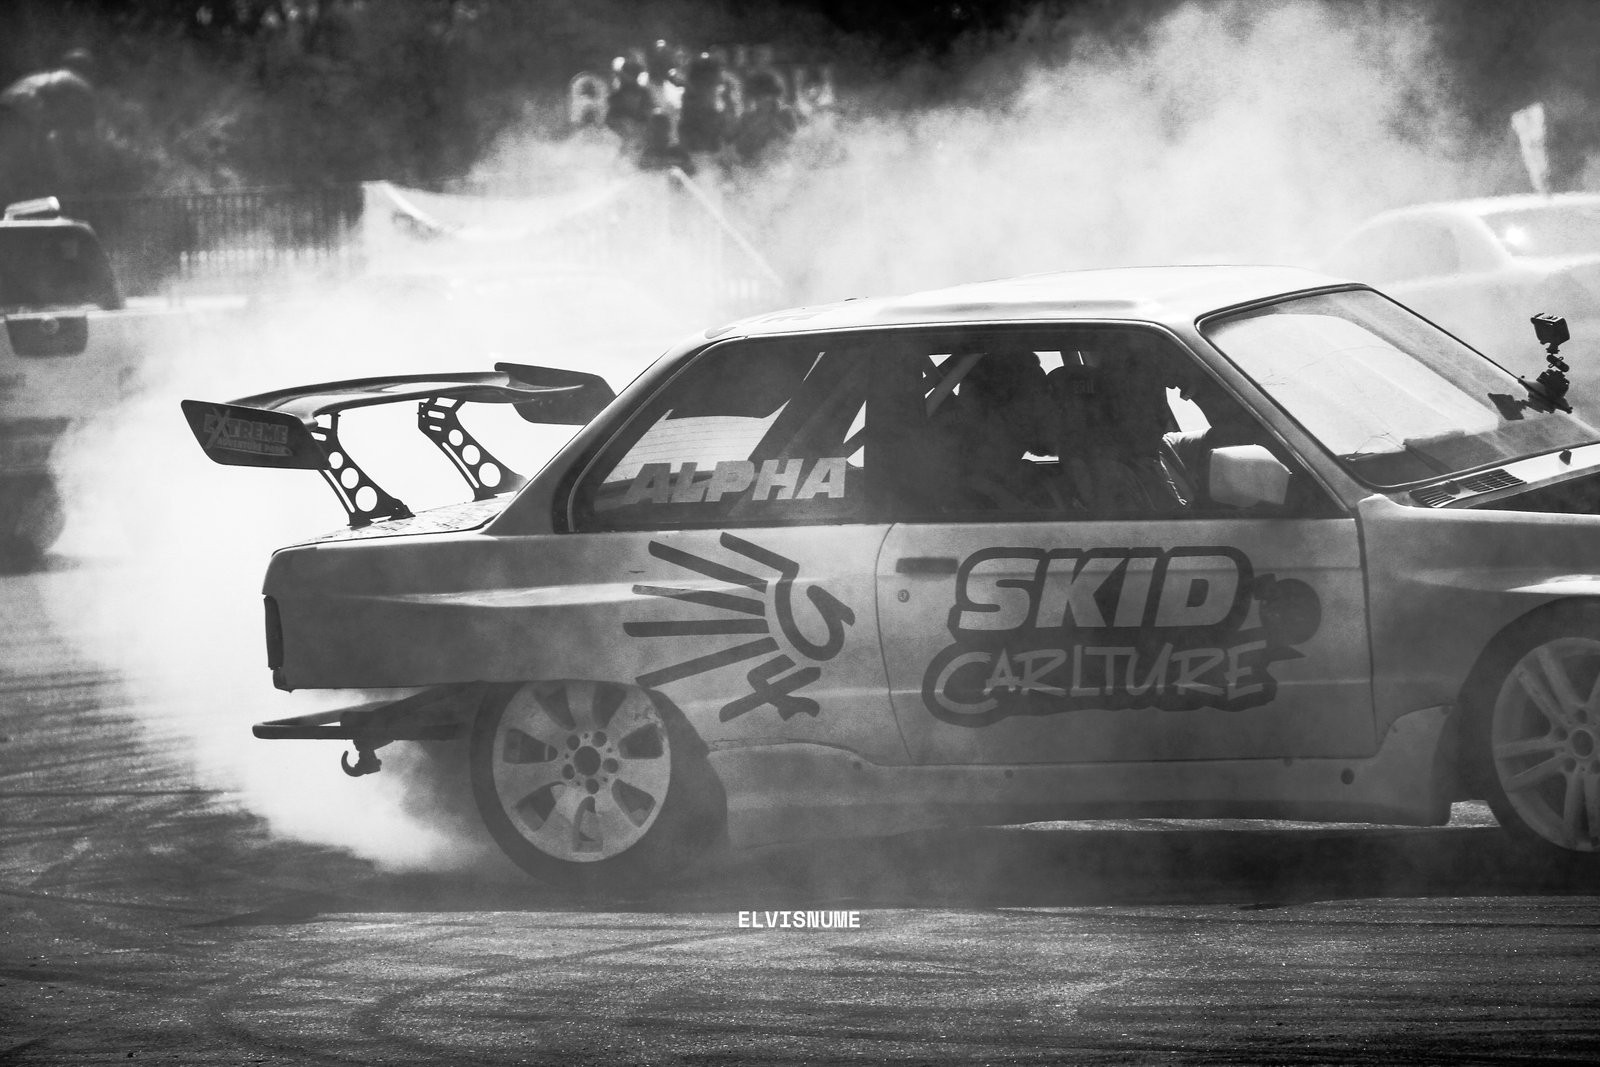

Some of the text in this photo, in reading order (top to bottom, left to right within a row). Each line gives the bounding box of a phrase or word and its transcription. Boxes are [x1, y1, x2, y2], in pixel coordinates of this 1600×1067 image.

[202, 407, 288, 449] EXTREME
[622, 457, 847, 505] ALPHA
[956, 553, 1241, 632] SKID
[934, 639, 1268, 714] CARLTURE
